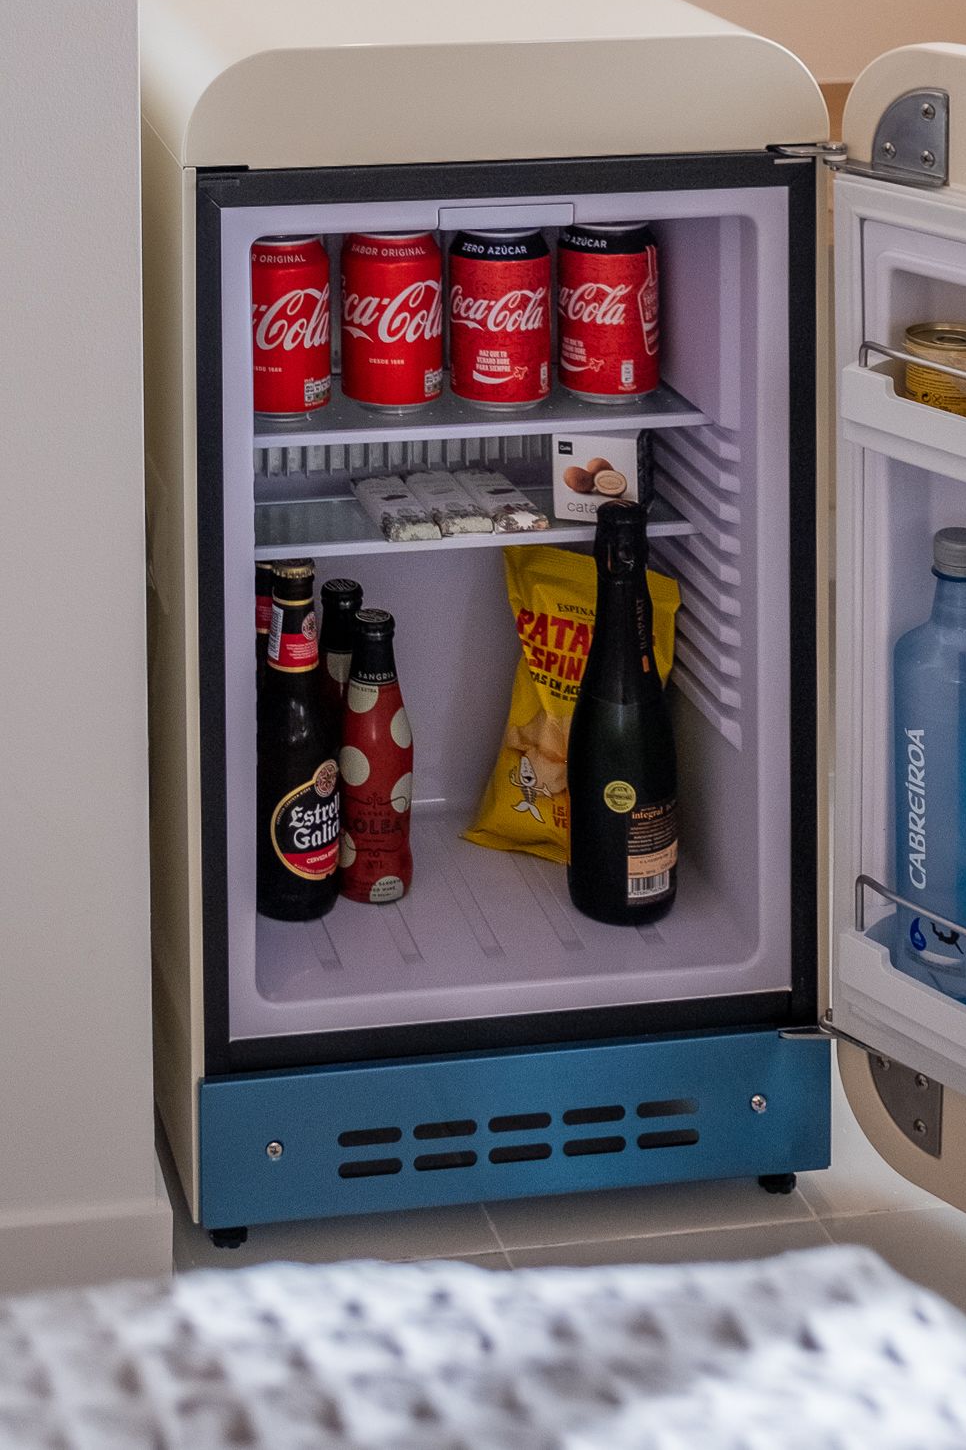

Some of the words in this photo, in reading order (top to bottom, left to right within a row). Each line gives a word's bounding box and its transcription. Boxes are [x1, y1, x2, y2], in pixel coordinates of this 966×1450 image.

[381, 246, 426, 257] ORIGINAL
[462, 242, 485, 254] ZERO
[487, 245, 528, 255] AZÚCAR
[260, 254, 306, 264] ORIGINAL
[451, 285, 548, 332] Coca-Cola
[557, 601, 597, 617] ESPINA
[516, 607, 594, 656] PATA
[549, 677, 562, 691] EN
[289, 792, 340, 828] Estrell
